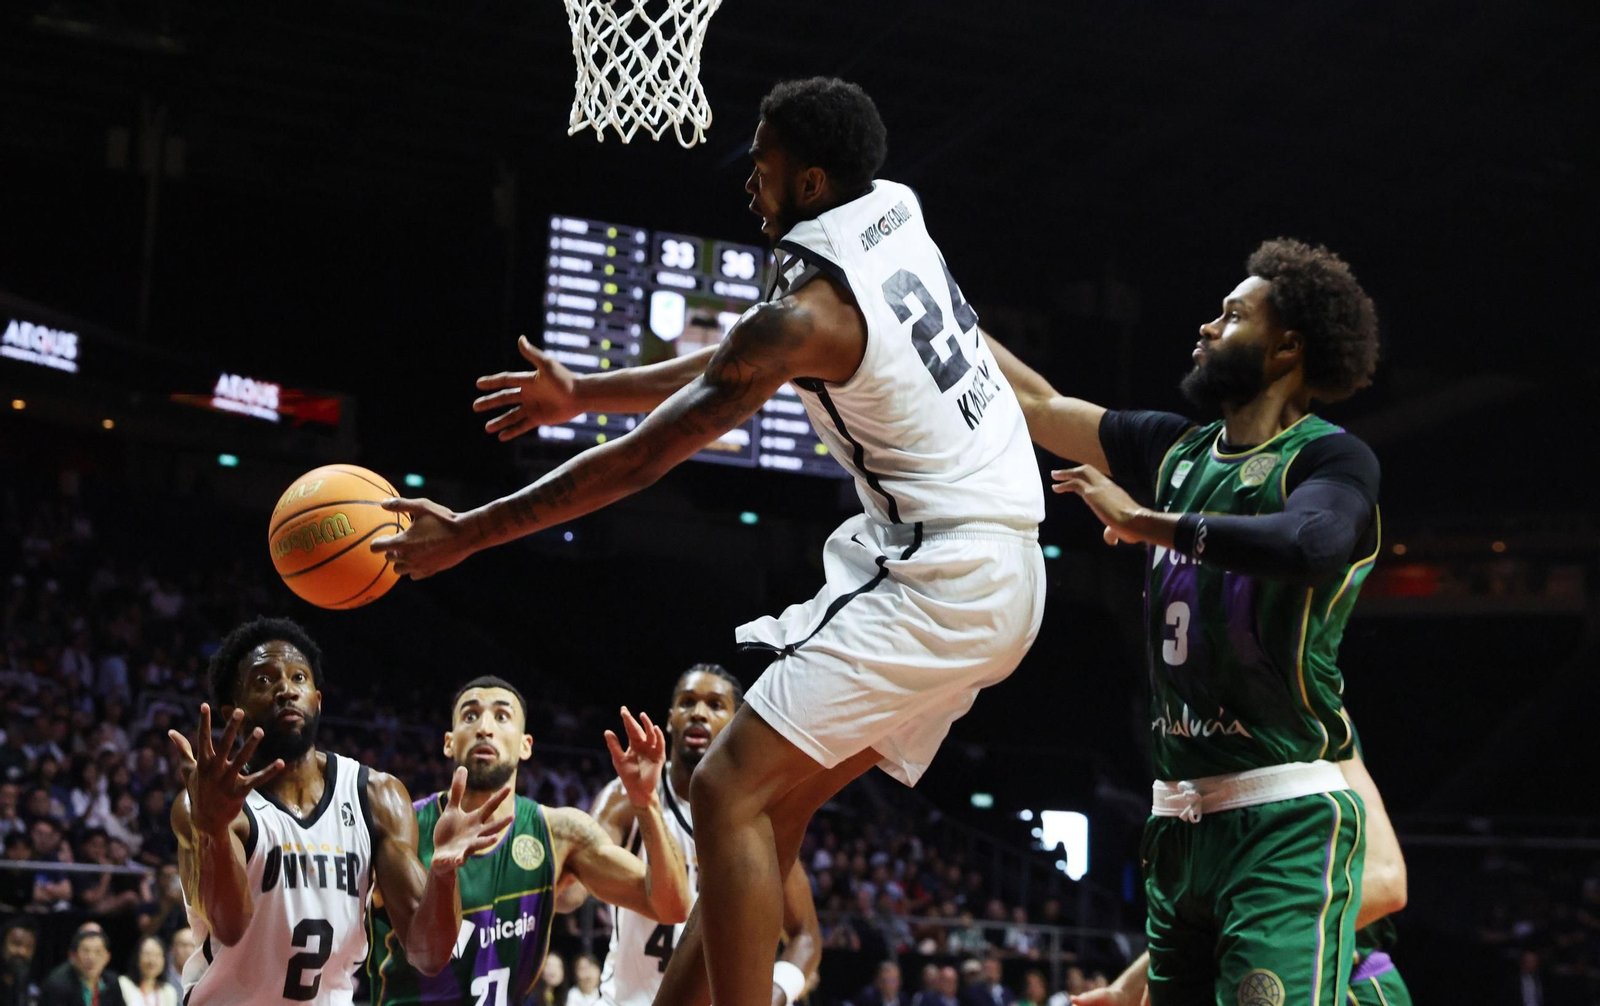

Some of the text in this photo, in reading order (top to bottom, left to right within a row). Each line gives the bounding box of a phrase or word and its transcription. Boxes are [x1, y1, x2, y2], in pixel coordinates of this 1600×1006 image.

[881, 251, 979, 394] 24
[272, 512, 355, 560] Wilson
[1162, 601, 1191, 666] 3
[262, 845, 361, 898] UNITED
[480, 912, 536, 948] Unicaja
[283, 919, 334, 1001] 2
